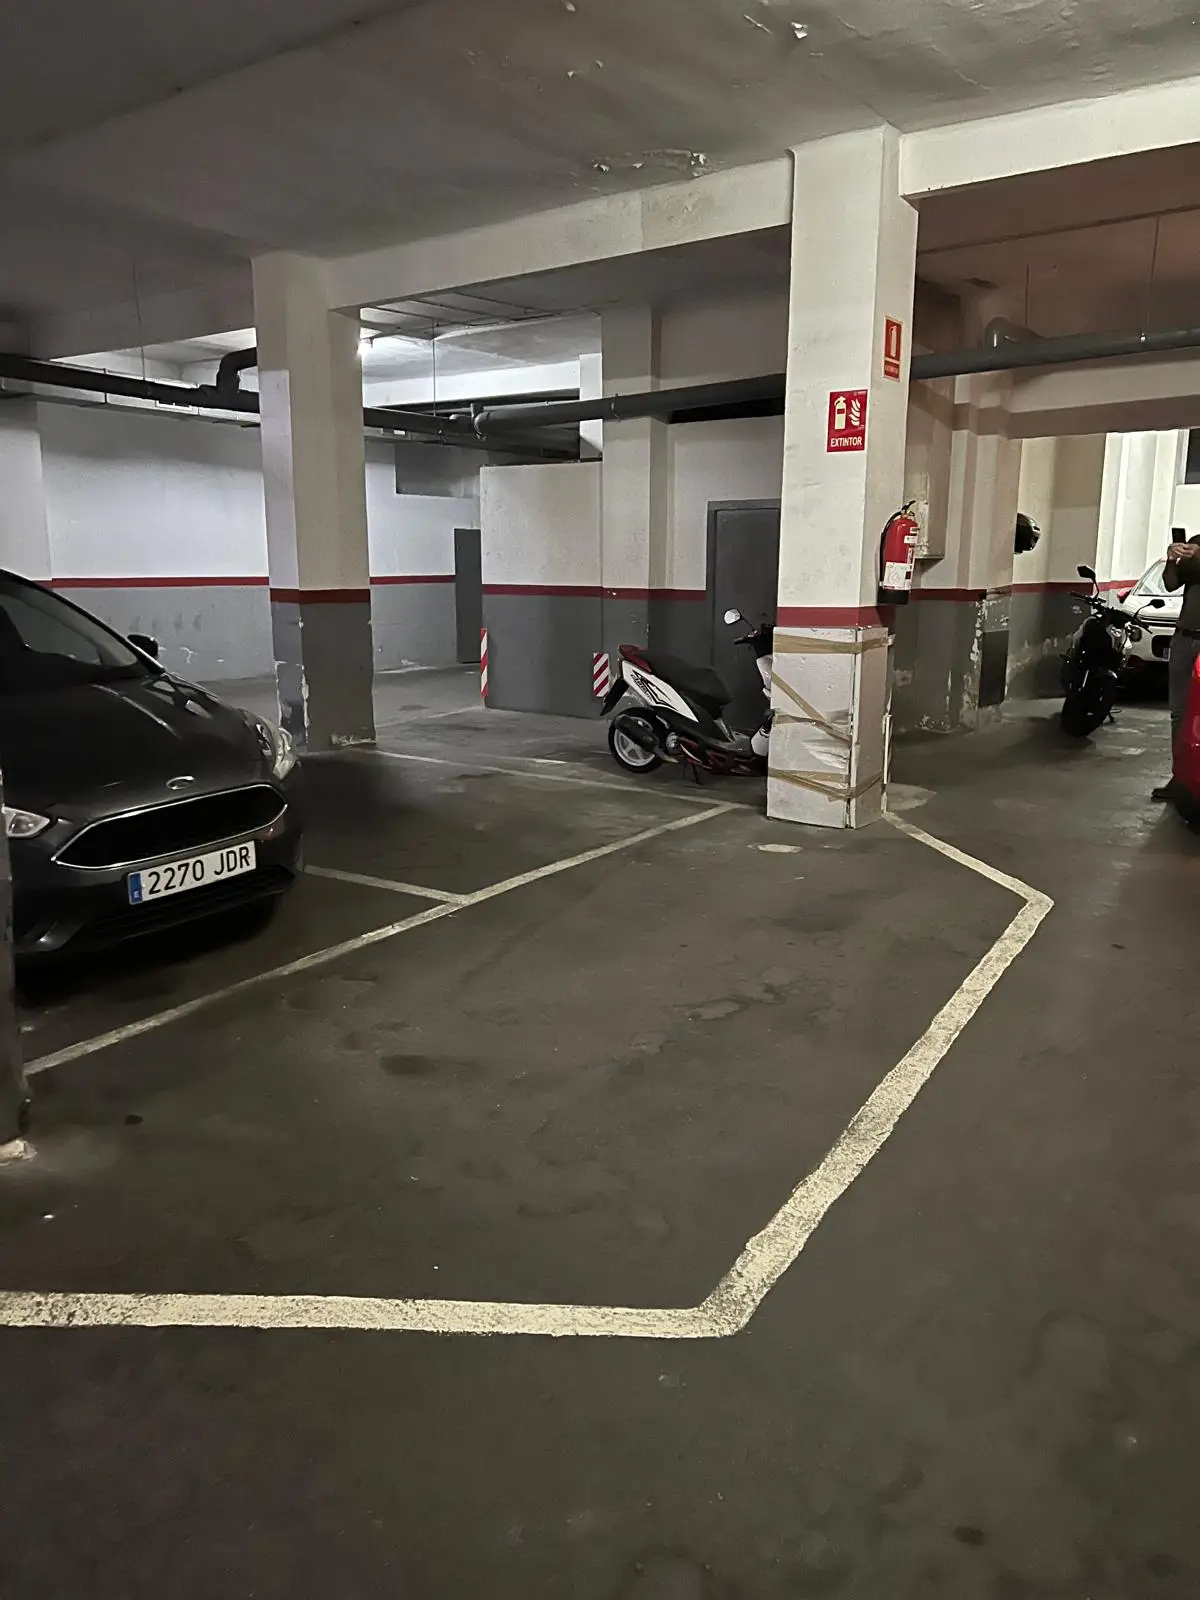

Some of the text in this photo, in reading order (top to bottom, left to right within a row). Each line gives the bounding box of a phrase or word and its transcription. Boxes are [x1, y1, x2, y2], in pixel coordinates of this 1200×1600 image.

[830, 436, 862, 447] EXTINTOR
[148, 846, 250, 895] 2270 JDR
